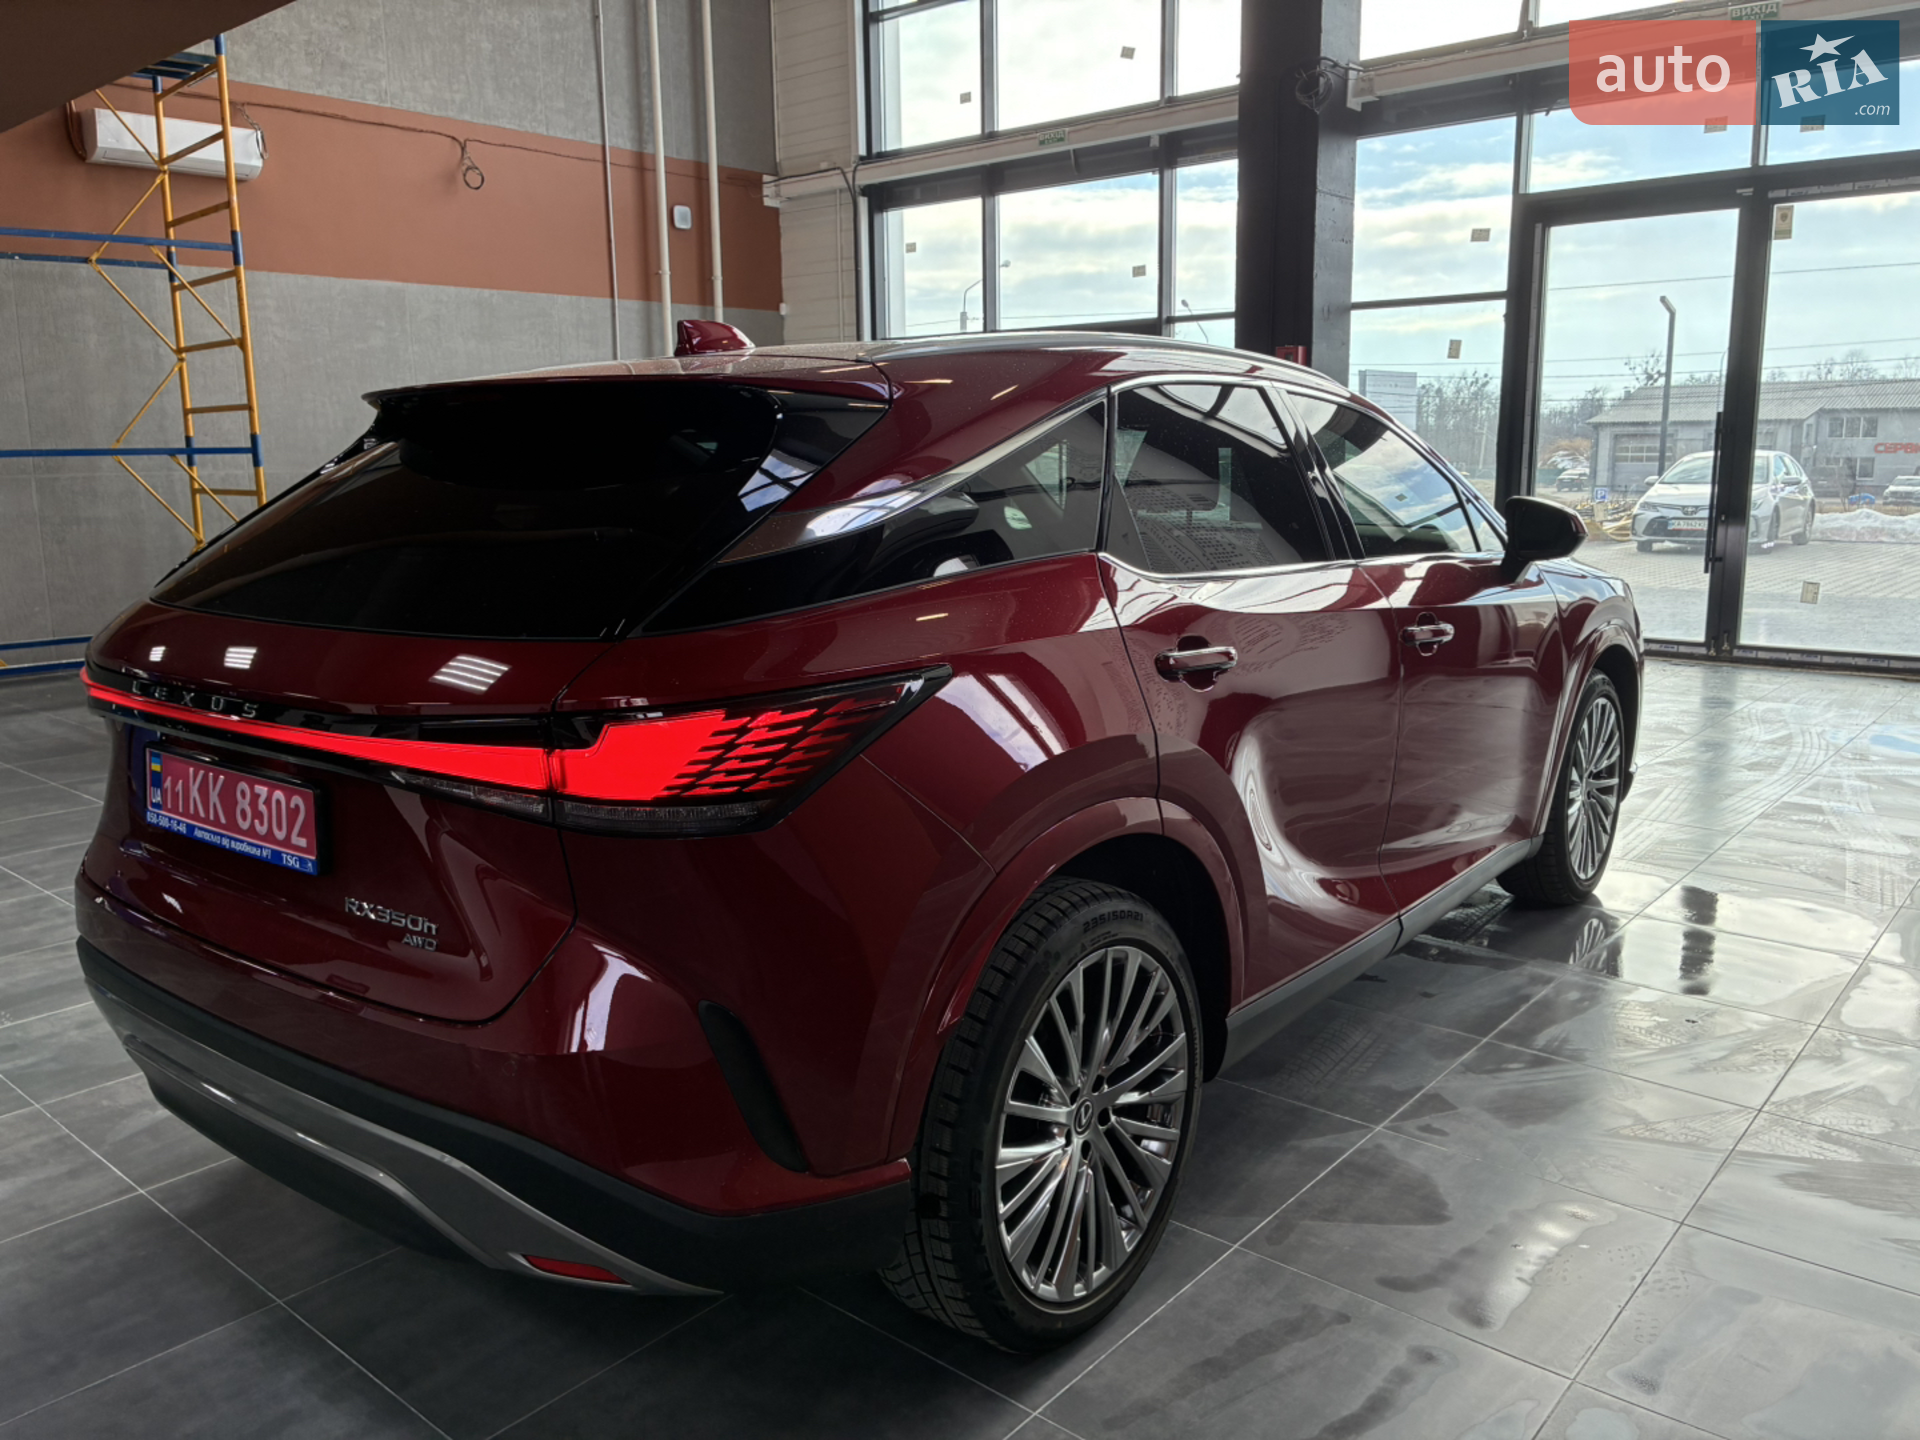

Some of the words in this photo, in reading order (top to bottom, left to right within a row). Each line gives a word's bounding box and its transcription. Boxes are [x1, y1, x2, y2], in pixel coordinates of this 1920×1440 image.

[1732, 3, 1777, 17] ВИХІД
[132, 680, 259, 718] LEXUS
[151, 786, 163, 804] UA
[236, 781, 307, 848] 8302
[281, 853, 300, 868] TSG
[402, 933, 438, 952] AWD
